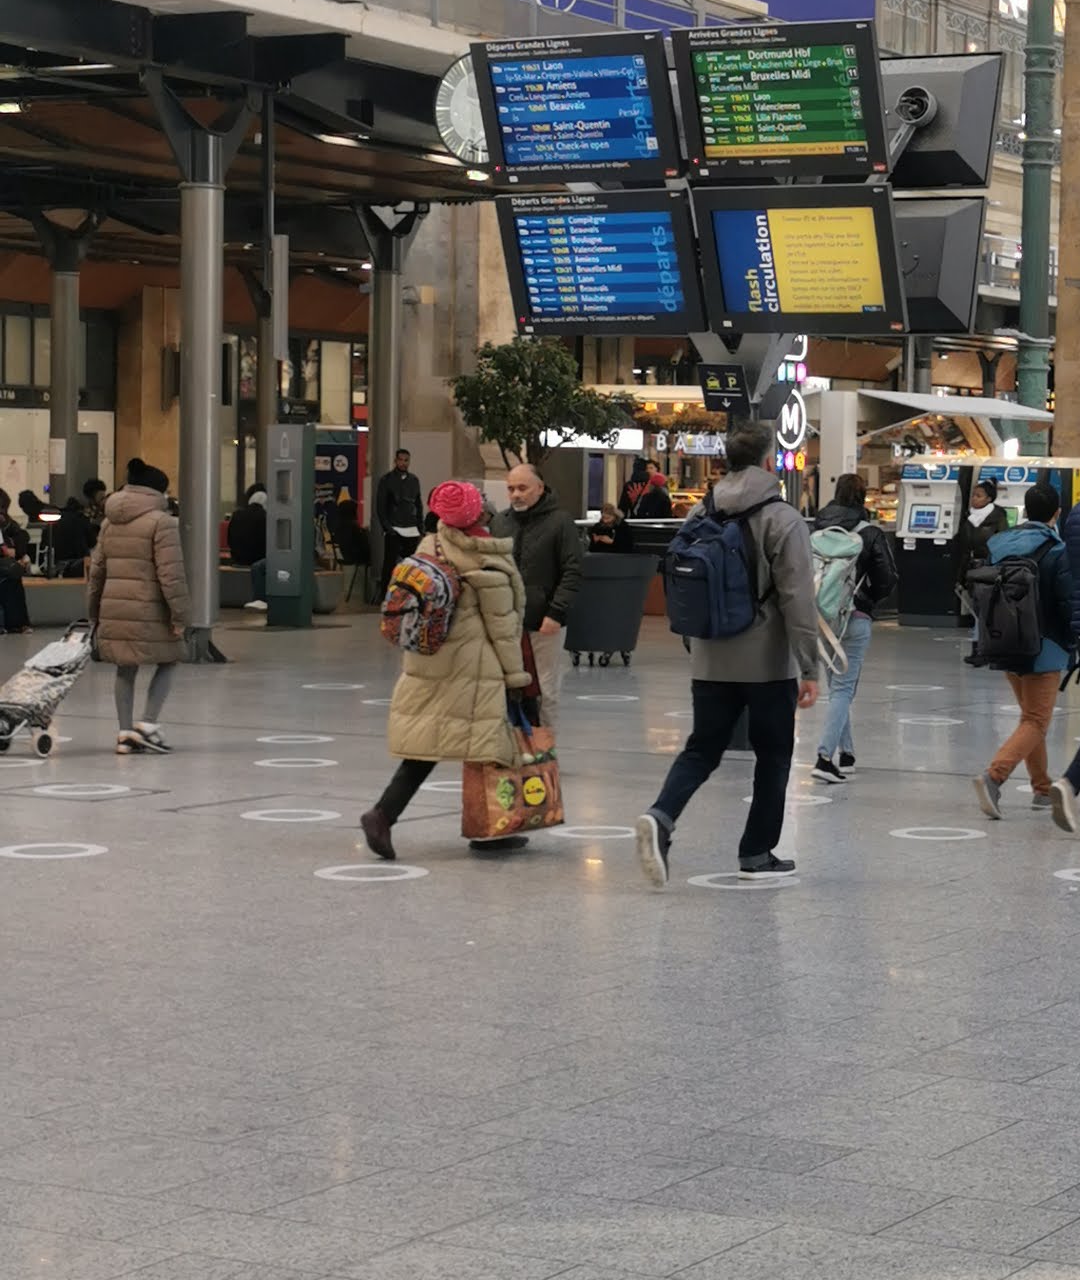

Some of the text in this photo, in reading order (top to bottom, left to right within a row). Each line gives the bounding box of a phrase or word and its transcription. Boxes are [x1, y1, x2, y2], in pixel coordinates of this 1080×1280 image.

[688, 31, 719, 39] Arrivées
[754, 28, 778, 37] Lignes
[486, 39, 570, 52] Départs Grandes Lignes
[748, 50, 793, 60] Dortmund
[795, 47, 811, 58] Hbf
[543, 61, 564, 70] Laon
[750, 70, 790, 81] Bruxelles
[792, 68, 811, 79] Midi
[546, 81, 577, 90] Amiens
[753, 93, 771, 101] Laon
[550, 100, 586, 111] Beauvais
[754, 103, 800, 111] Valenciennes
[553, 120, 611, 131] Saint-Quentin
[511, 196, 595, 206] Départs Grandes Lignes
[652, 225, 678, 312] départs
[756, 214, 780, 312] circulation
[745, 269, 763, 312] flash
